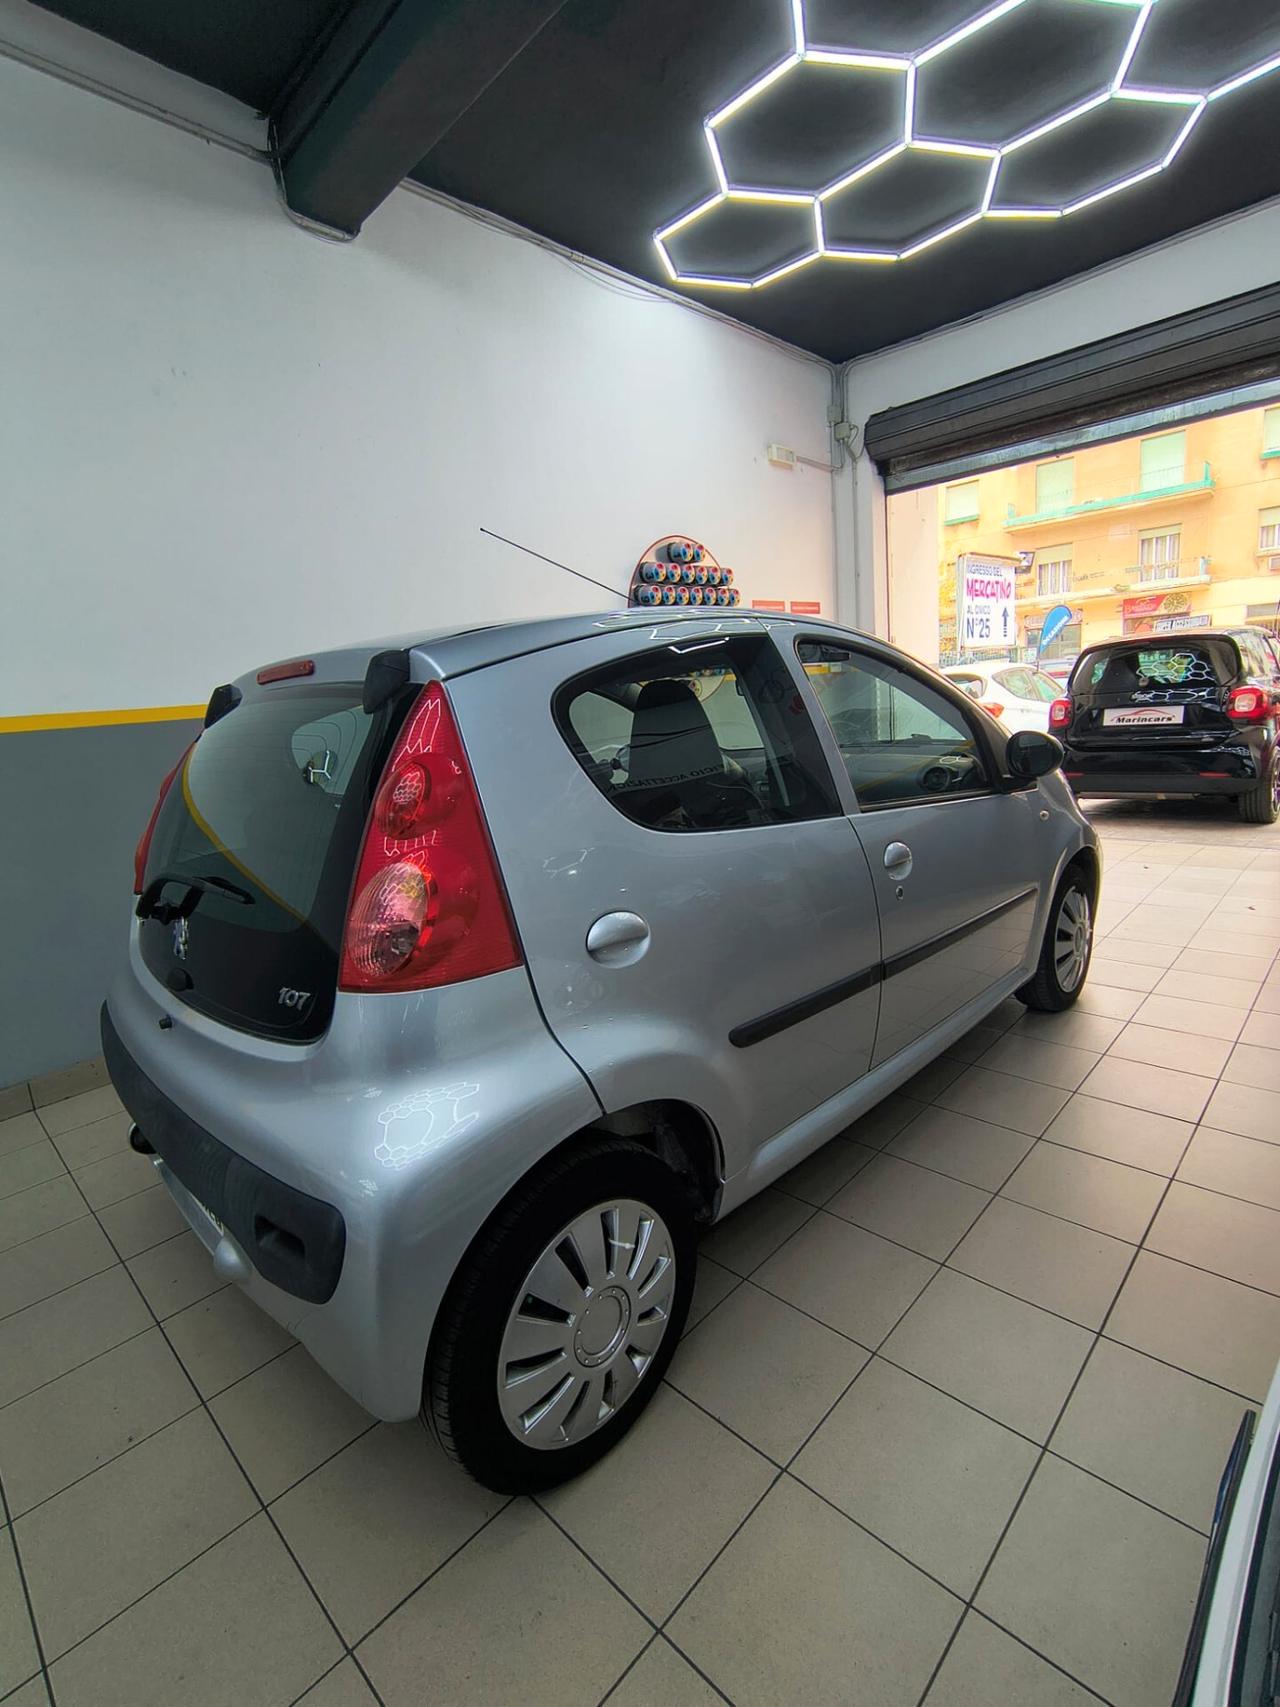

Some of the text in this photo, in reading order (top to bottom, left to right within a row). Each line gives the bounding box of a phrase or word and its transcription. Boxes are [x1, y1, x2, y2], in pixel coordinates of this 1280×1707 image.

[966, 578, 1012, 602] MERCATINO
[967, 605, 974, 614] AL
[1116, 716, 1173, 724] Marincars
[278, 987, 311, 1010] 107
